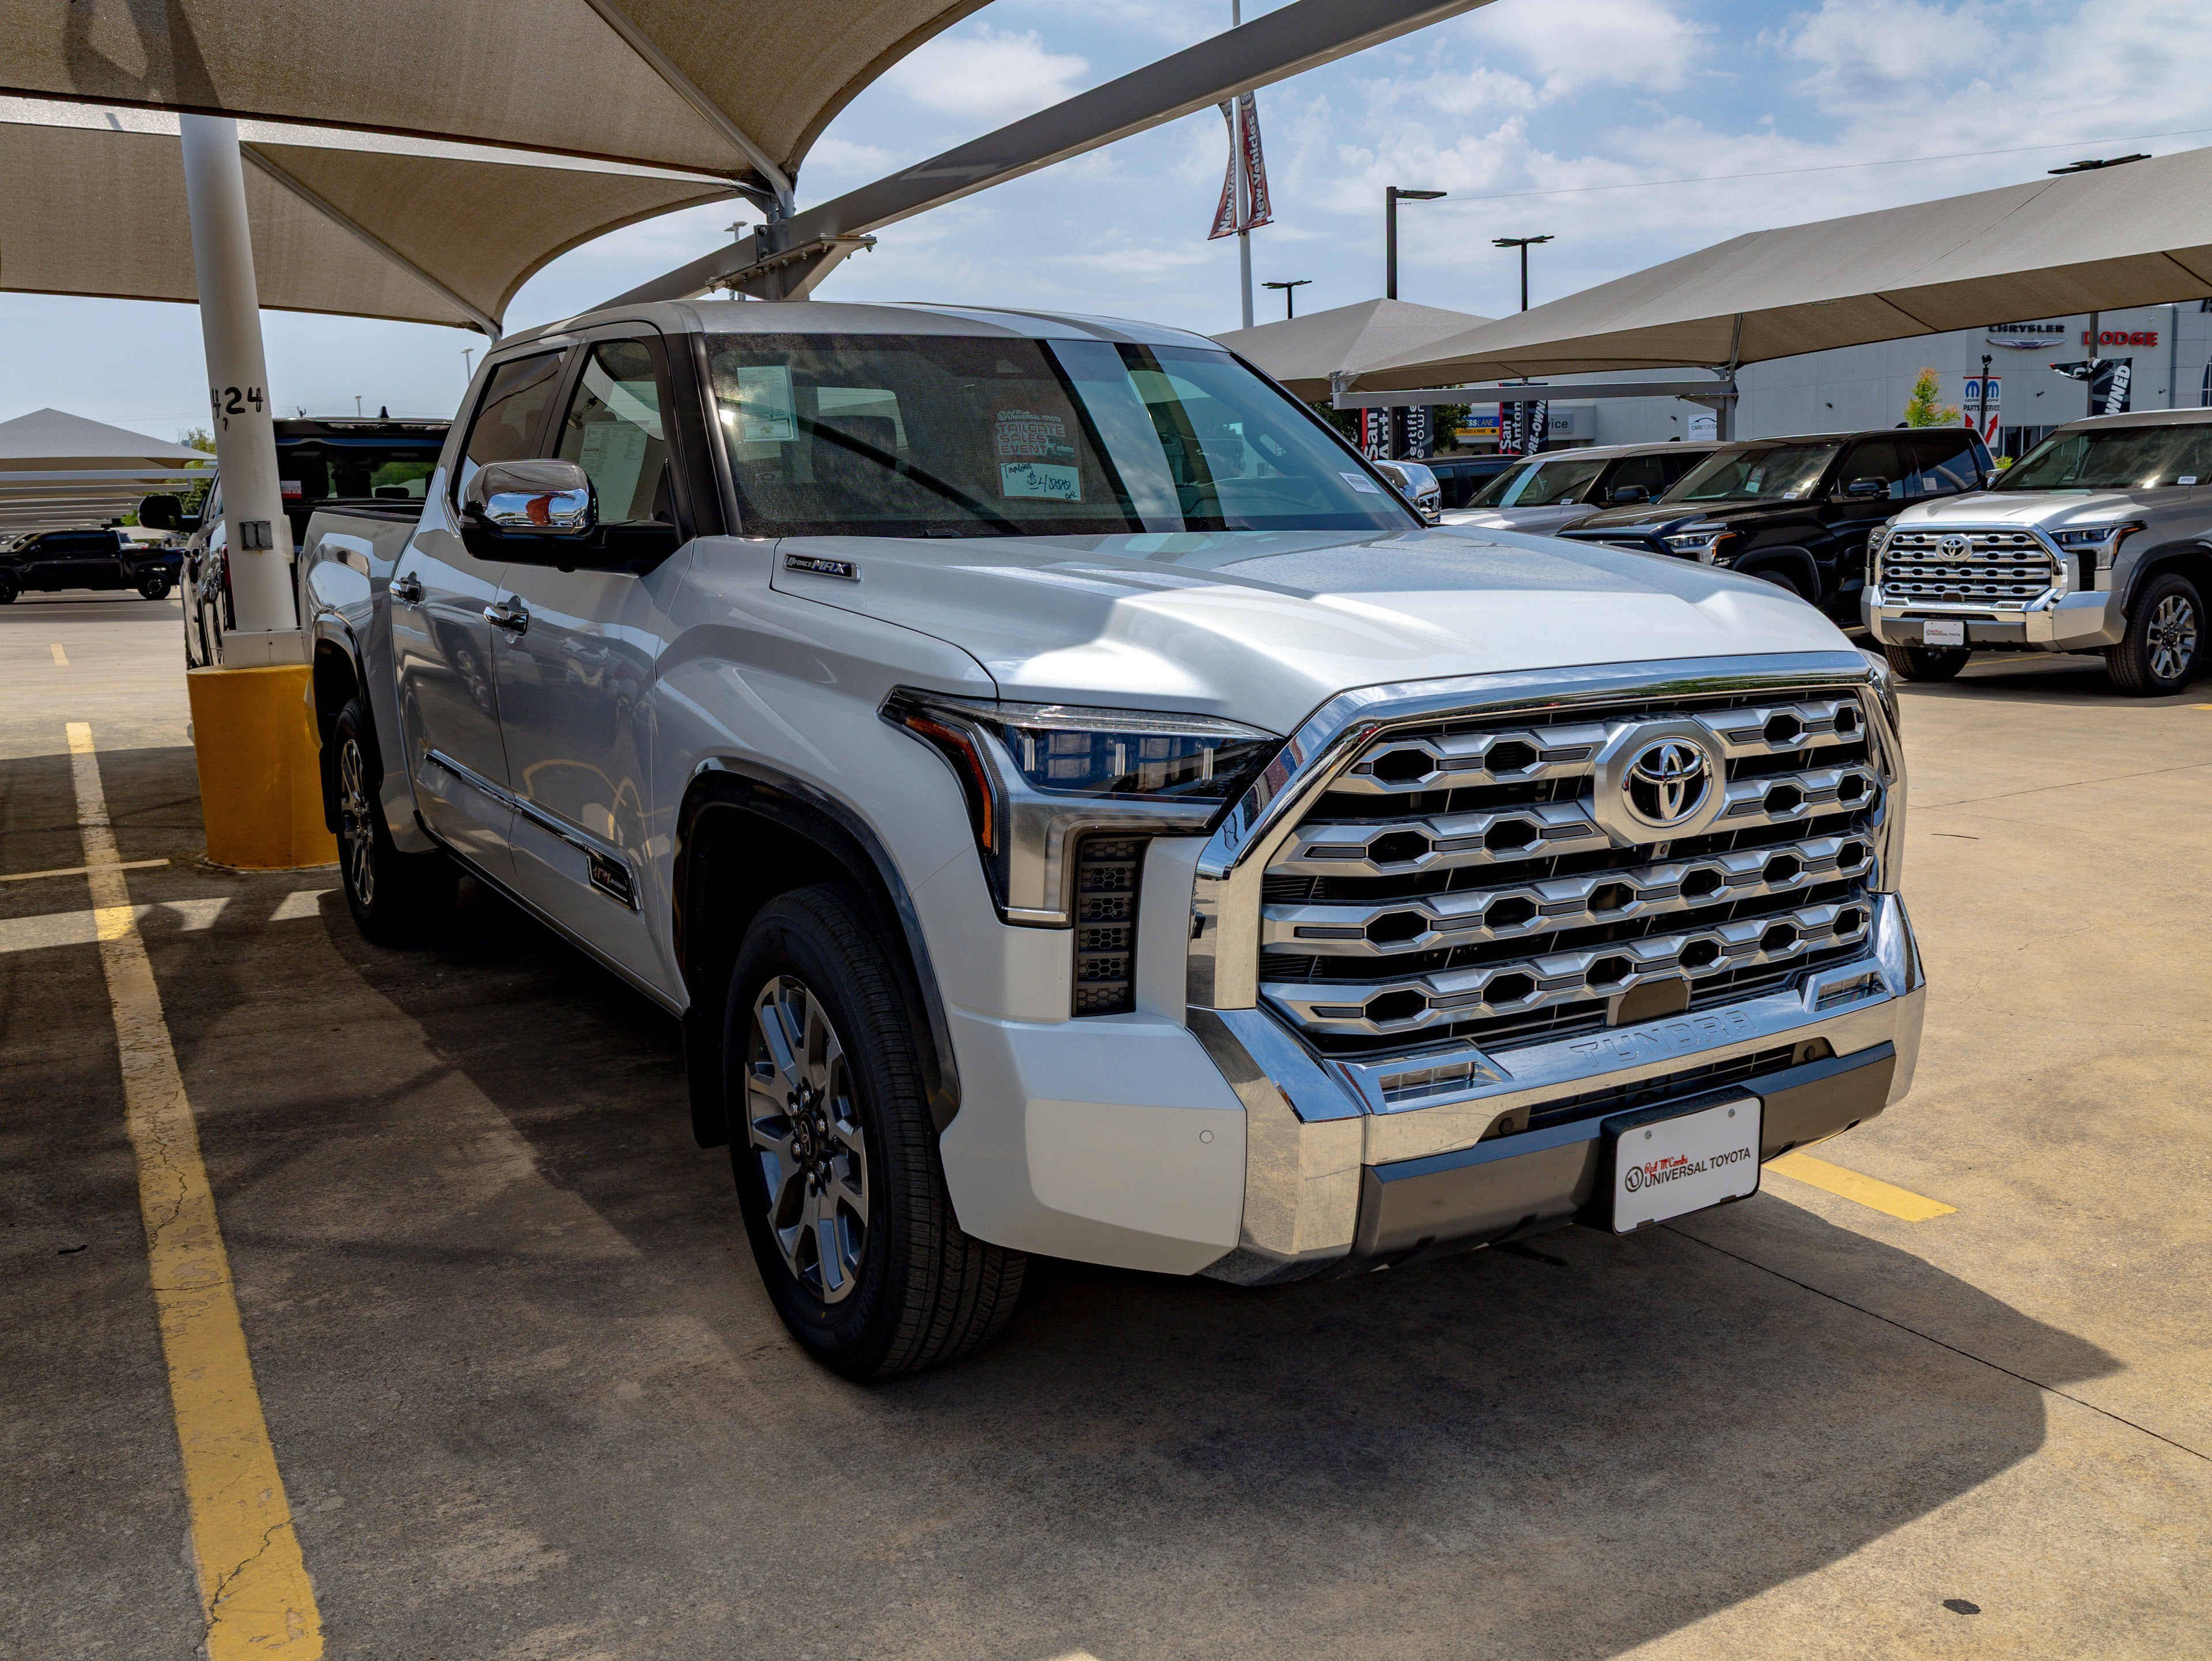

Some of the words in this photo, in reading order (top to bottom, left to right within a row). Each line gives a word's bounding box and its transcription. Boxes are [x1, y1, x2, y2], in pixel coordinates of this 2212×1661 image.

[1248, 115, 1261, 186] Vehicles
[1218, 198, 1233, 232] New
[1255, 188, 1266, 220] New
[1988, 324, 2065, 333] CHRYSLER
[2104, 365, 2131, 414] WNED
[997, 423, 1064, 437] TAILGATE
[999, 433, 1047, 444] SALES
[1363, 413, 1378, 460] San
[1407, 405, 1417, 460] ertifie
[1500, 420, 1512, 450] San
[1512, 402, 1522, 450] Anton
[1528, 400, 1547, 456] PRE-OWN
[1001, 444, 1047, 455] EVENT
[811, 559, 850, 574] MAX
[1569, 1010, 1758, 1068] TUNDRA
[1645, 1160, 1707, 1188] UNIVERSAL
[1709, 1147, 1751, 1170] TOYOTA
[1645, 1161, 1658, 1176] Red
